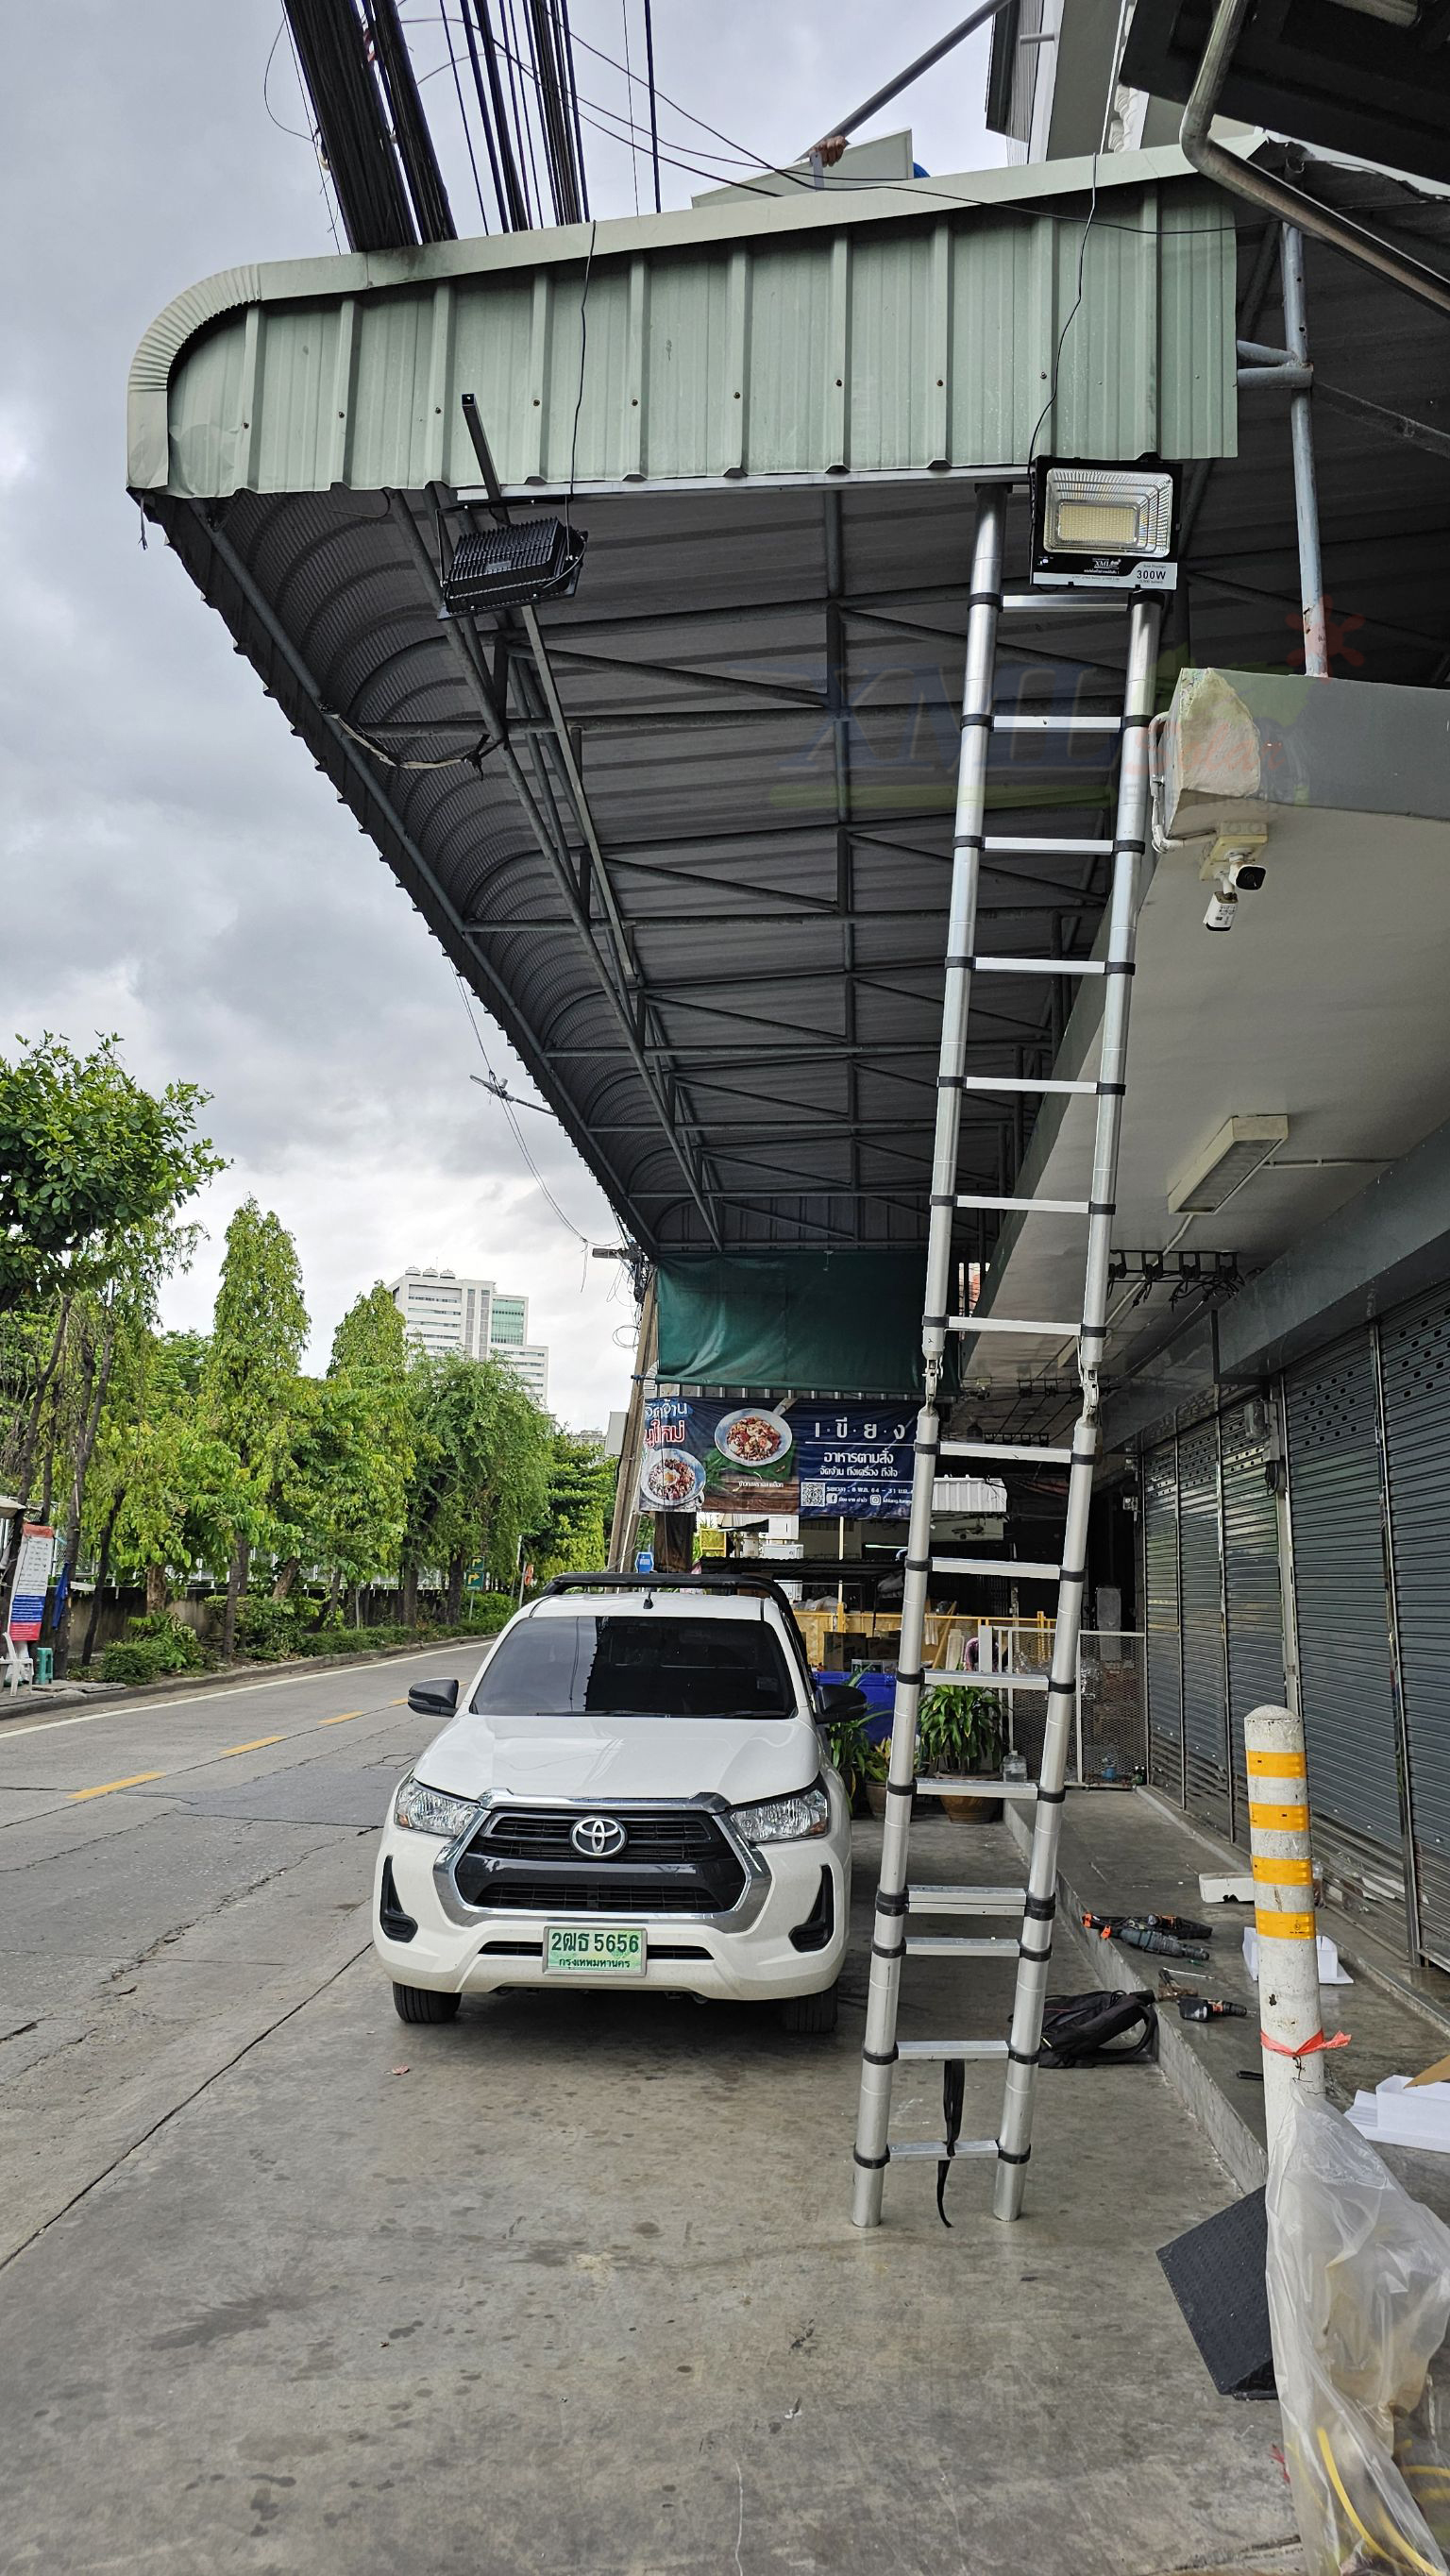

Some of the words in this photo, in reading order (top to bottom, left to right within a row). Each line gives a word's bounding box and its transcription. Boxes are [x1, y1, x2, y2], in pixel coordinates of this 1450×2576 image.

[1137, 569, 1166, 580] 300W
[823, 1449, 894, 1465] อาหารตามสั่ง
[551, 1932, 590, 1952] 2ฒธ
[594, 1933, 639, 1954] 5656
[559, 1957, 631, 1970] กรุงเทพมหานคร
